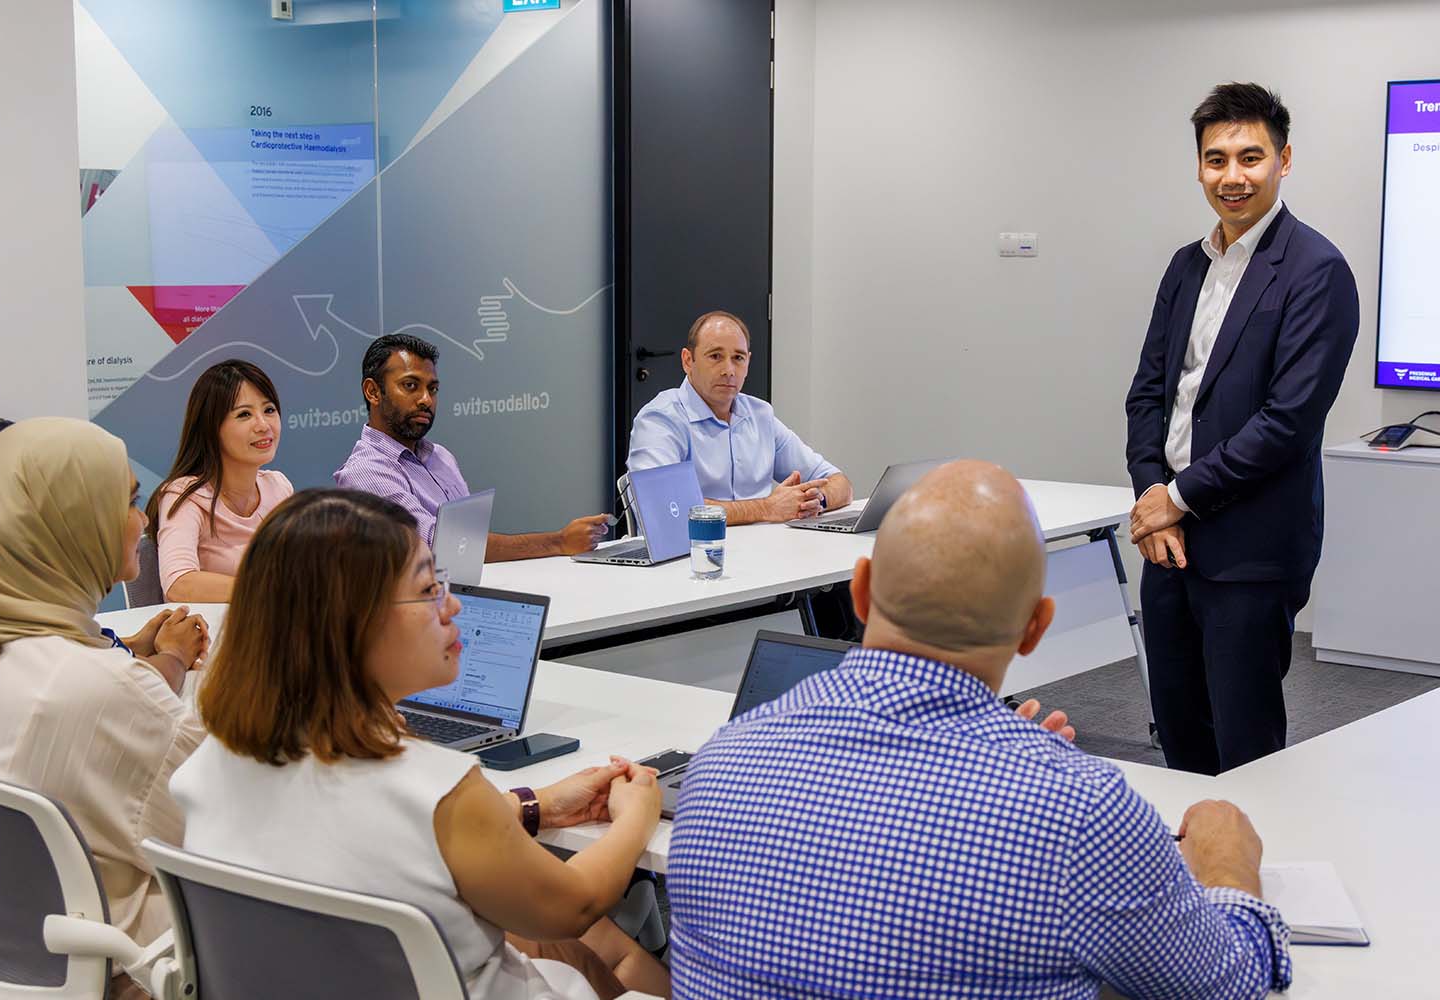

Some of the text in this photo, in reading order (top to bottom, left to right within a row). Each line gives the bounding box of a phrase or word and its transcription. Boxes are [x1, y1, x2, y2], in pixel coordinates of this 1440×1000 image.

[250, 105, 272, 117] 2016
[250, 128, 271, 138] Taking
[273, 130, 282, 138] the
[299, 132, 313, 140] step
[314, 132, 320, 140] in
[250, 140, 346, 153] Cardioprotective Haemodialysis
[97, 356, 104, 365] of
[106, 356, 133, 366] dialysis
